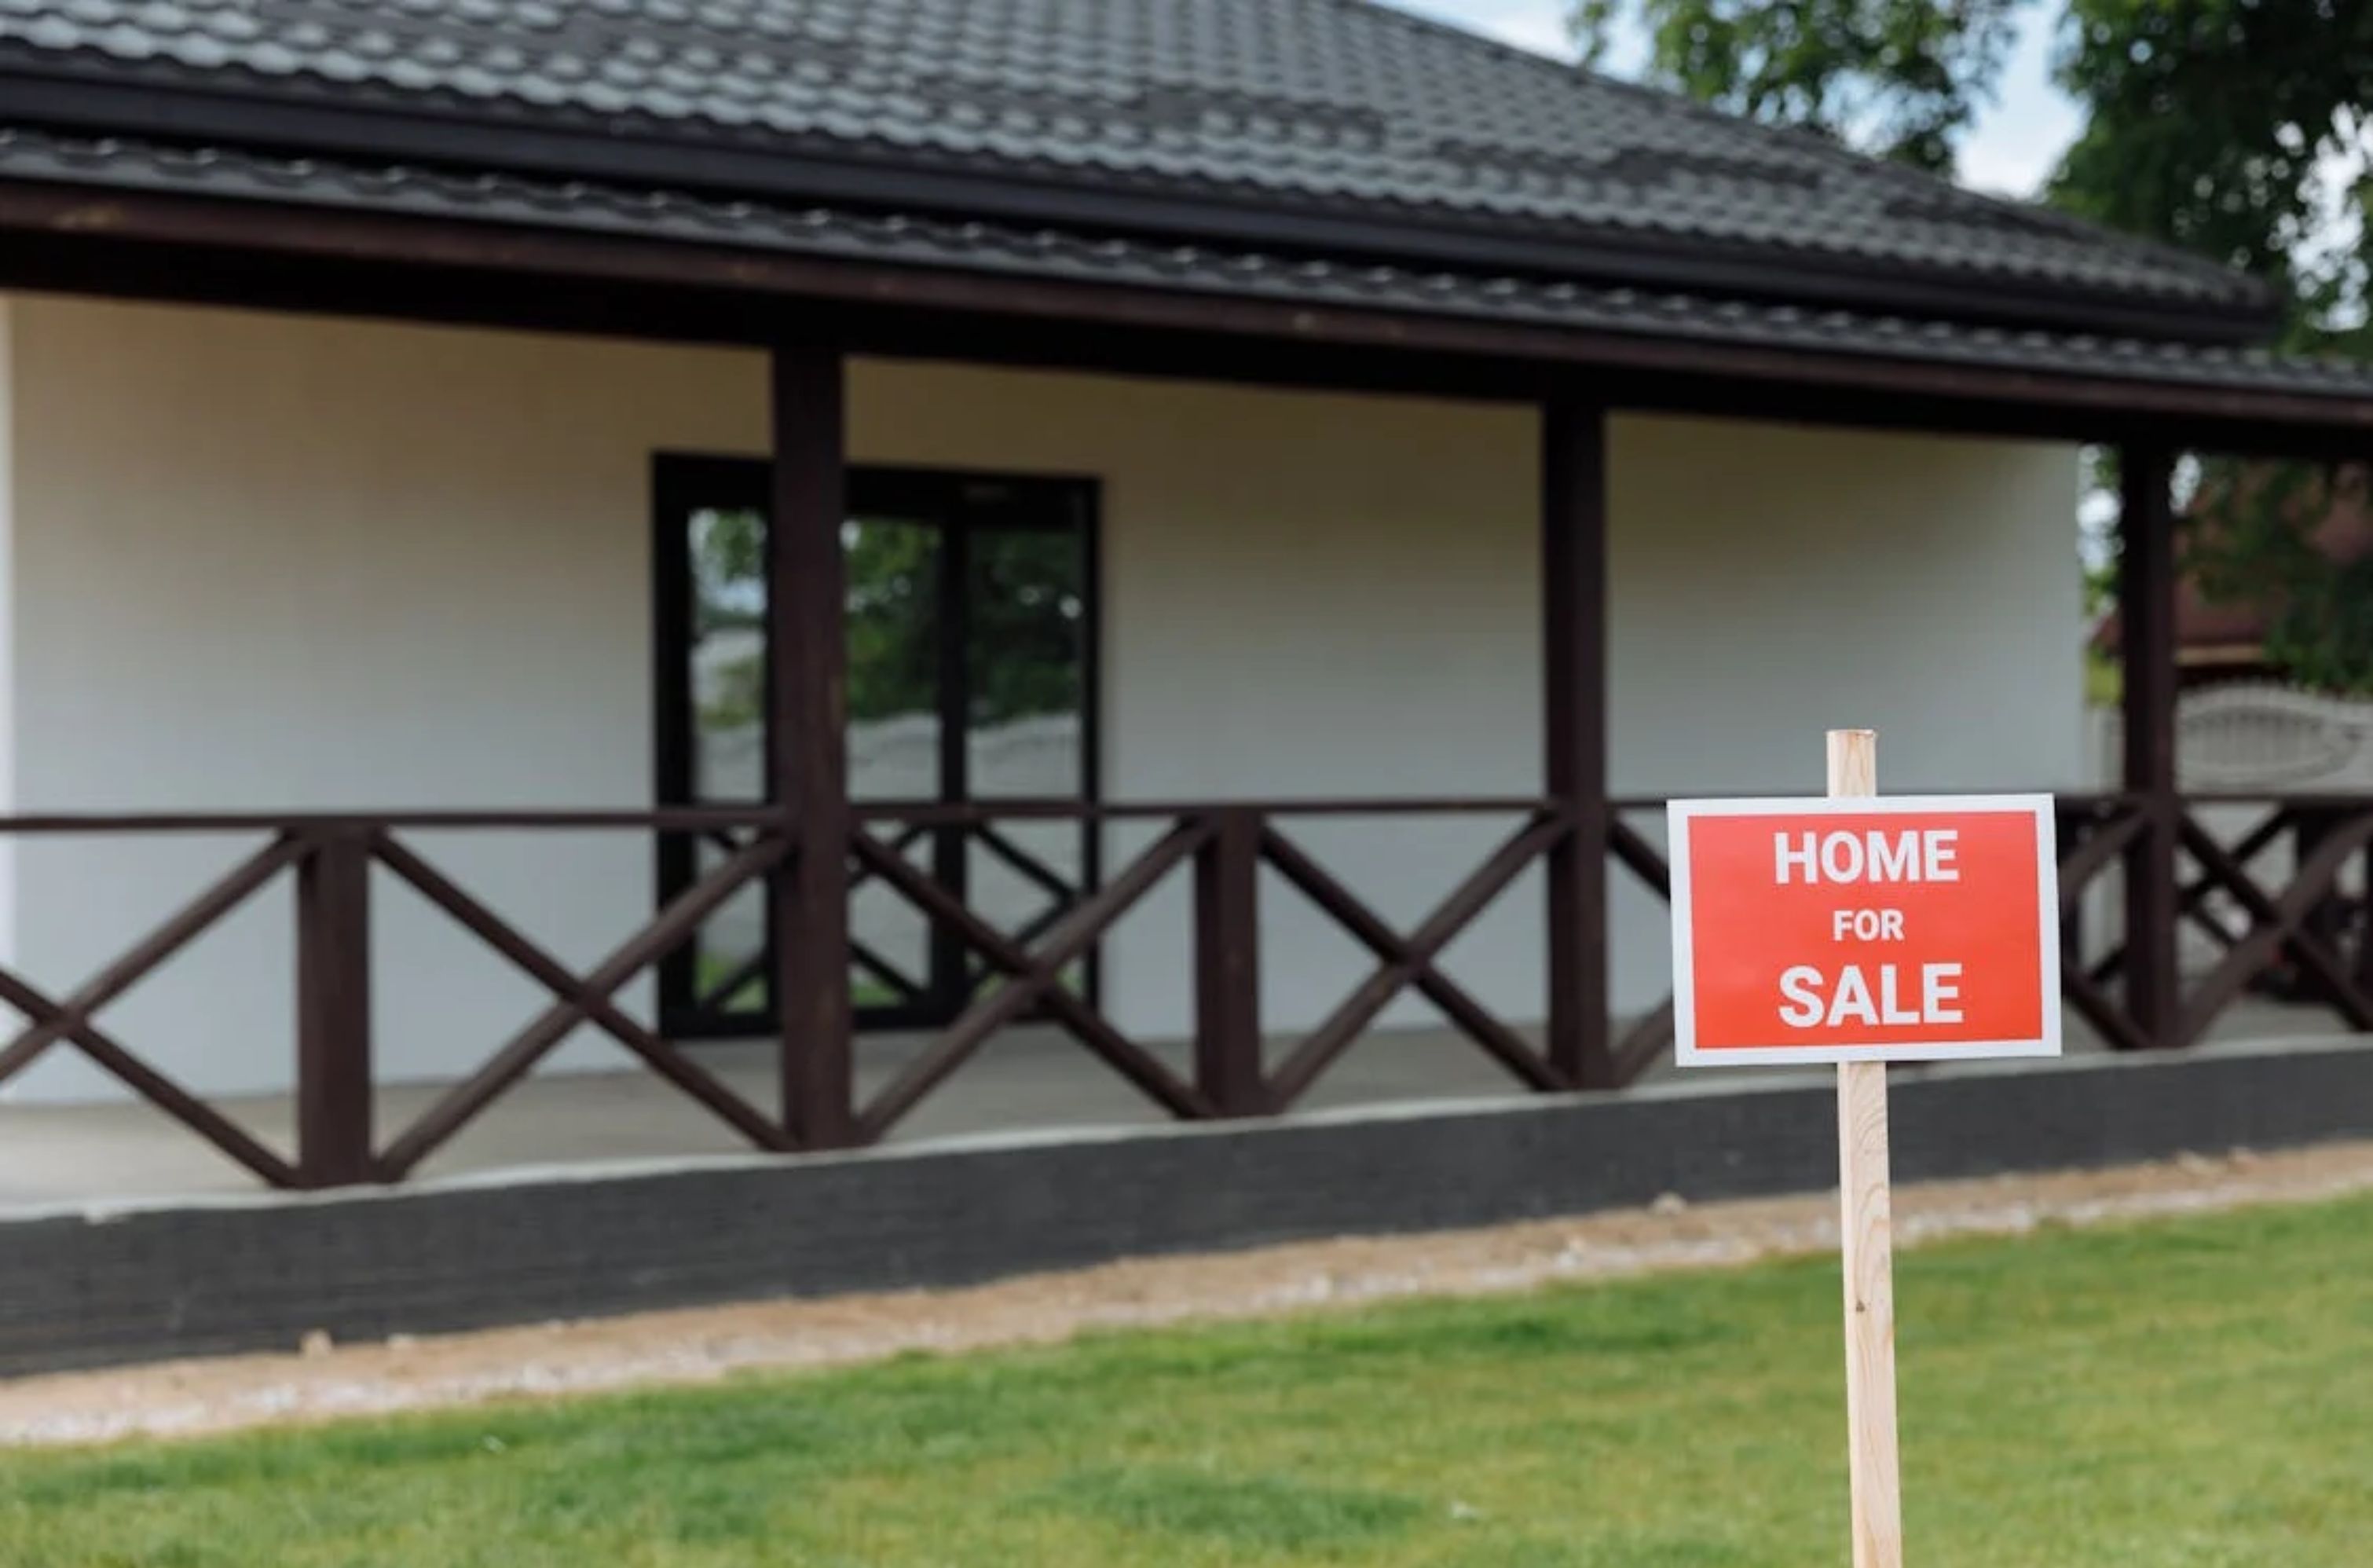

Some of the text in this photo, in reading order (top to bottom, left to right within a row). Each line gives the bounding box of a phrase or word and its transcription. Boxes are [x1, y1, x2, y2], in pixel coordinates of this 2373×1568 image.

[1774, 829, 1959, 885] HOME
[1833, 908, 1905, 942] FOR
[1778, 962, 1963, 1028] SALE
